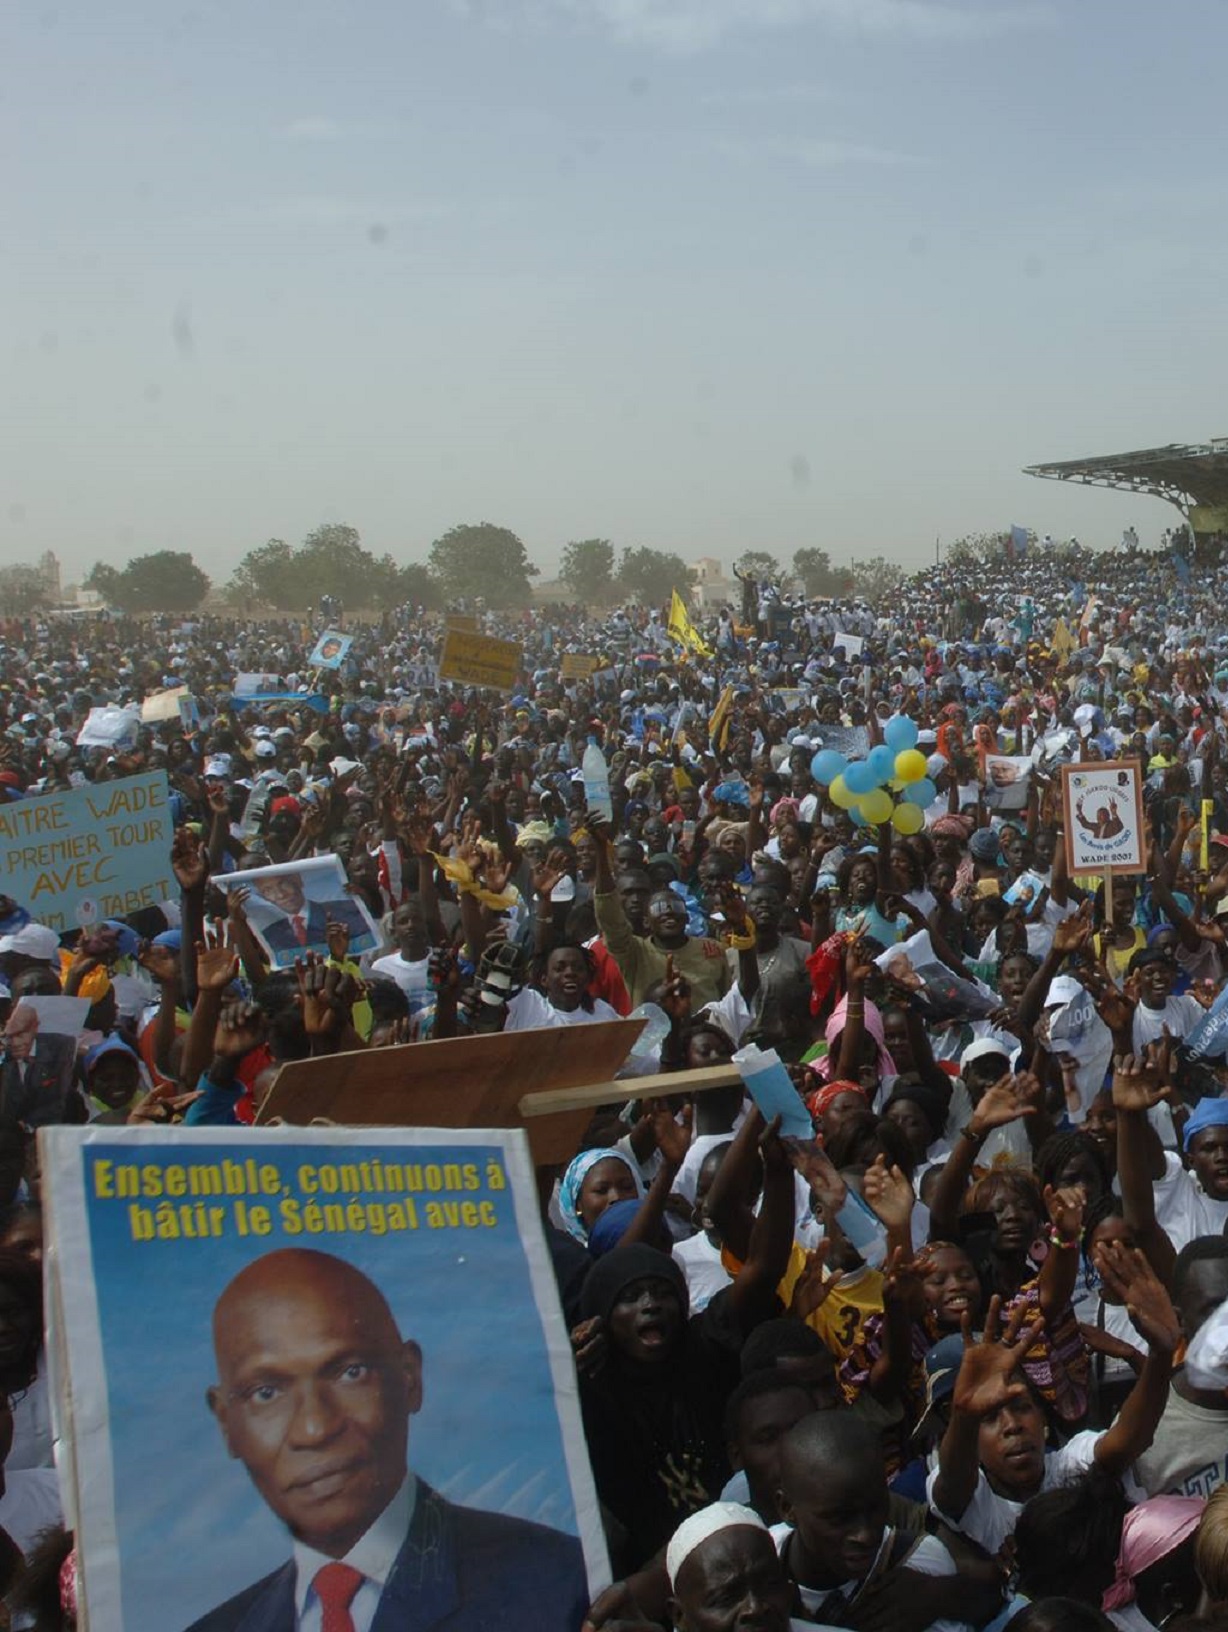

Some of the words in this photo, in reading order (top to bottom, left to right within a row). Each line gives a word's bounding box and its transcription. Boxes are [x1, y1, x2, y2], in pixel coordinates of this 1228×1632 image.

[86, 783, 166, 821] WADE
[105, 820, 163, 848] TOUR
[1081, 854, 1110, 864] WADE
[1111, 852, 1133, 863] 2007
[30, 855, 119, 900] AVEC
[99, 880, 170, 917] TABET
[93, 1158, 289, 1199] Ensemble,
[298, 1157, 482, 1195] continuons
[486, 1157, 505, 1191] à
[128, 1200, 225, 1242] bâtir
[233, 1200, 272, 1237] le
[278, 1194, 418, 1237] Sénégal
[425, 1199, 499, 1230] avec
